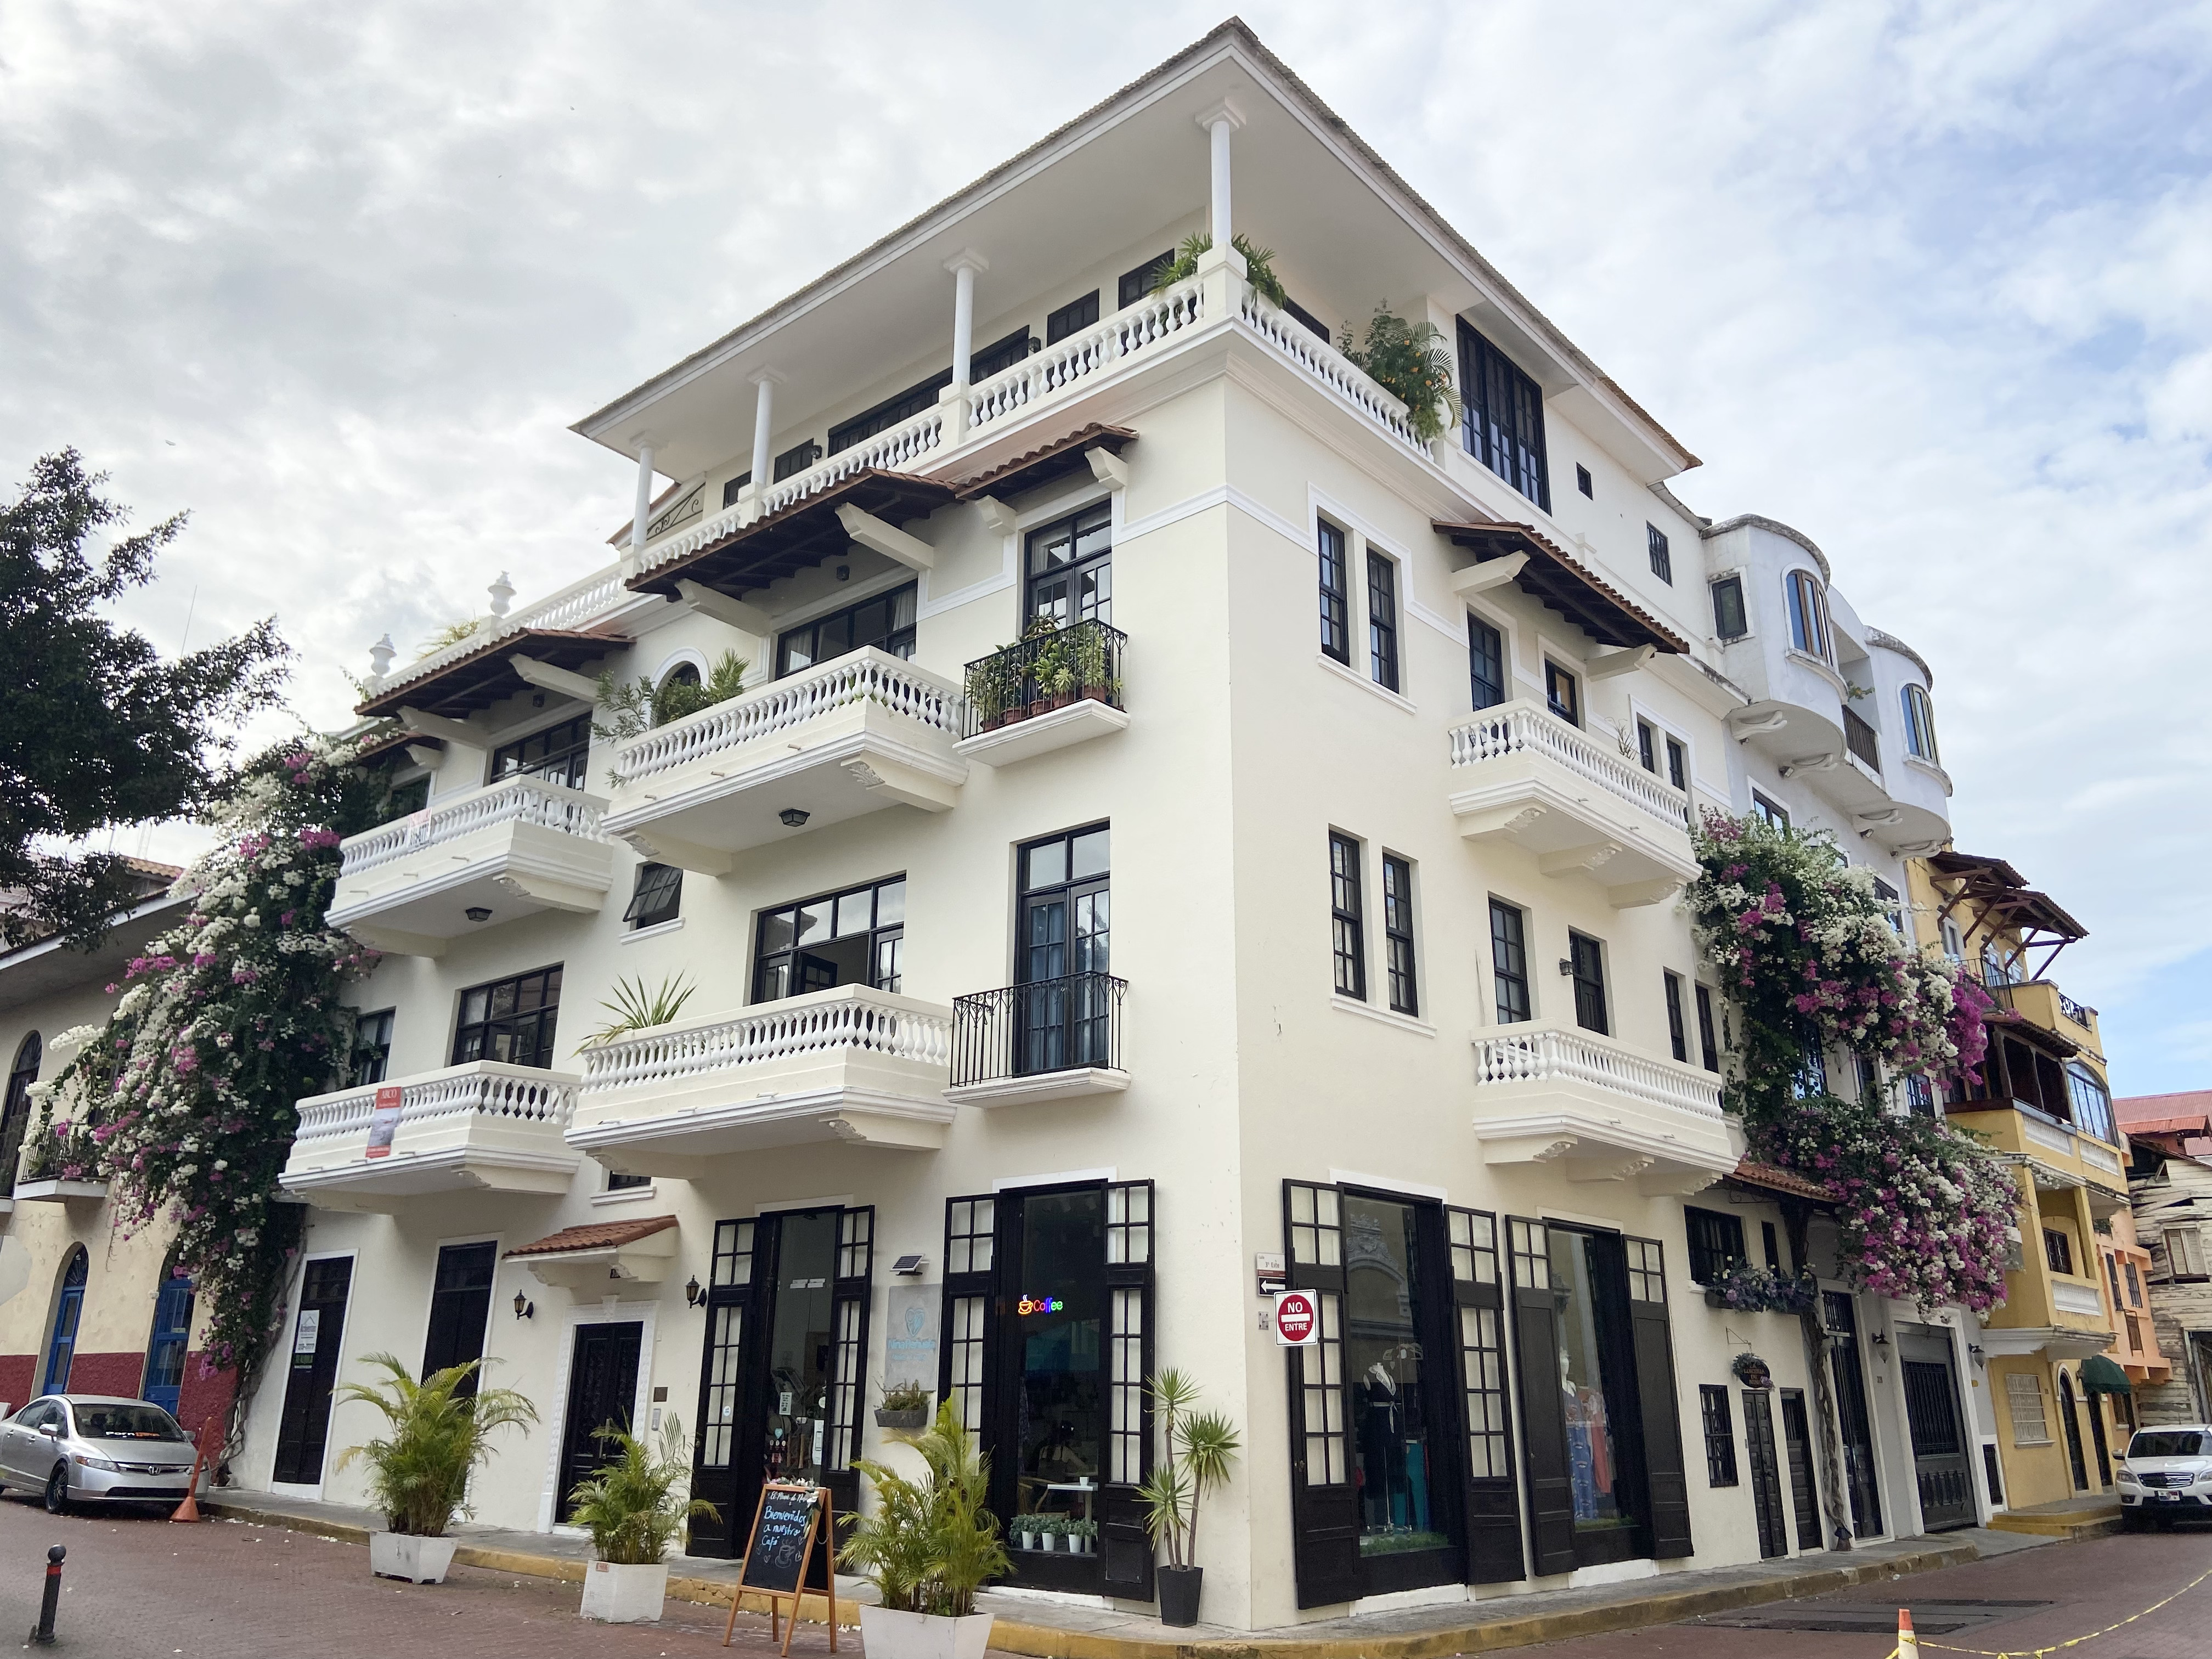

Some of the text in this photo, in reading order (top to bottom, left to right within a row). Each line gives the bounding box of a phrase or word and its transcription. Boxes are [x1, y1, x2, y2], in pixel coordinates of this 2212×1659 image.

[1034, 1297, 1063, 1313] Coffee
[1287, 1301, 1303, 1313] NO
[1285, 1323, 1307, 1331] ENTRE
[764, 1505, 806, 1527] Bienvenidos
[763, 1524, 801, 1537] a nuestro
[761, 1534, 780, 1551] Café
